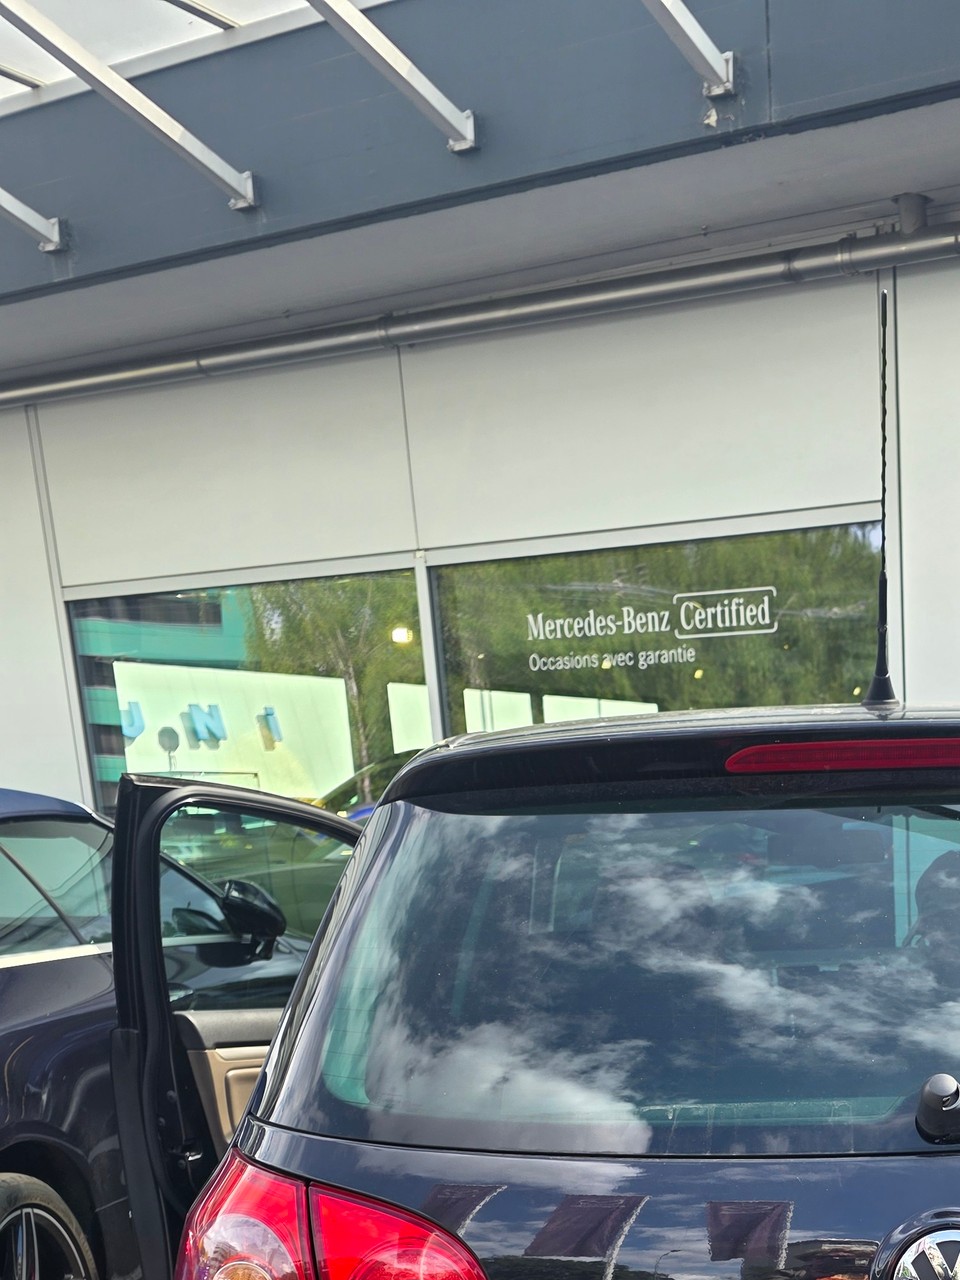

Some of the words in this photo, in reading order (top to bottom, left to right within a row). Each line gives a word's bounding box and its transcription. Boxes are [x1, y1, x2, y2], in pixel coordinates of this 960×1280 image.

[527, 606, 671, 640] Mercedes-Benz
[680, 595, 770, 631] Certified
[529, 651, 598, 671] Occasions
[602, 651, 634, 668] avec
[638, 644, 696, 669] garantie
